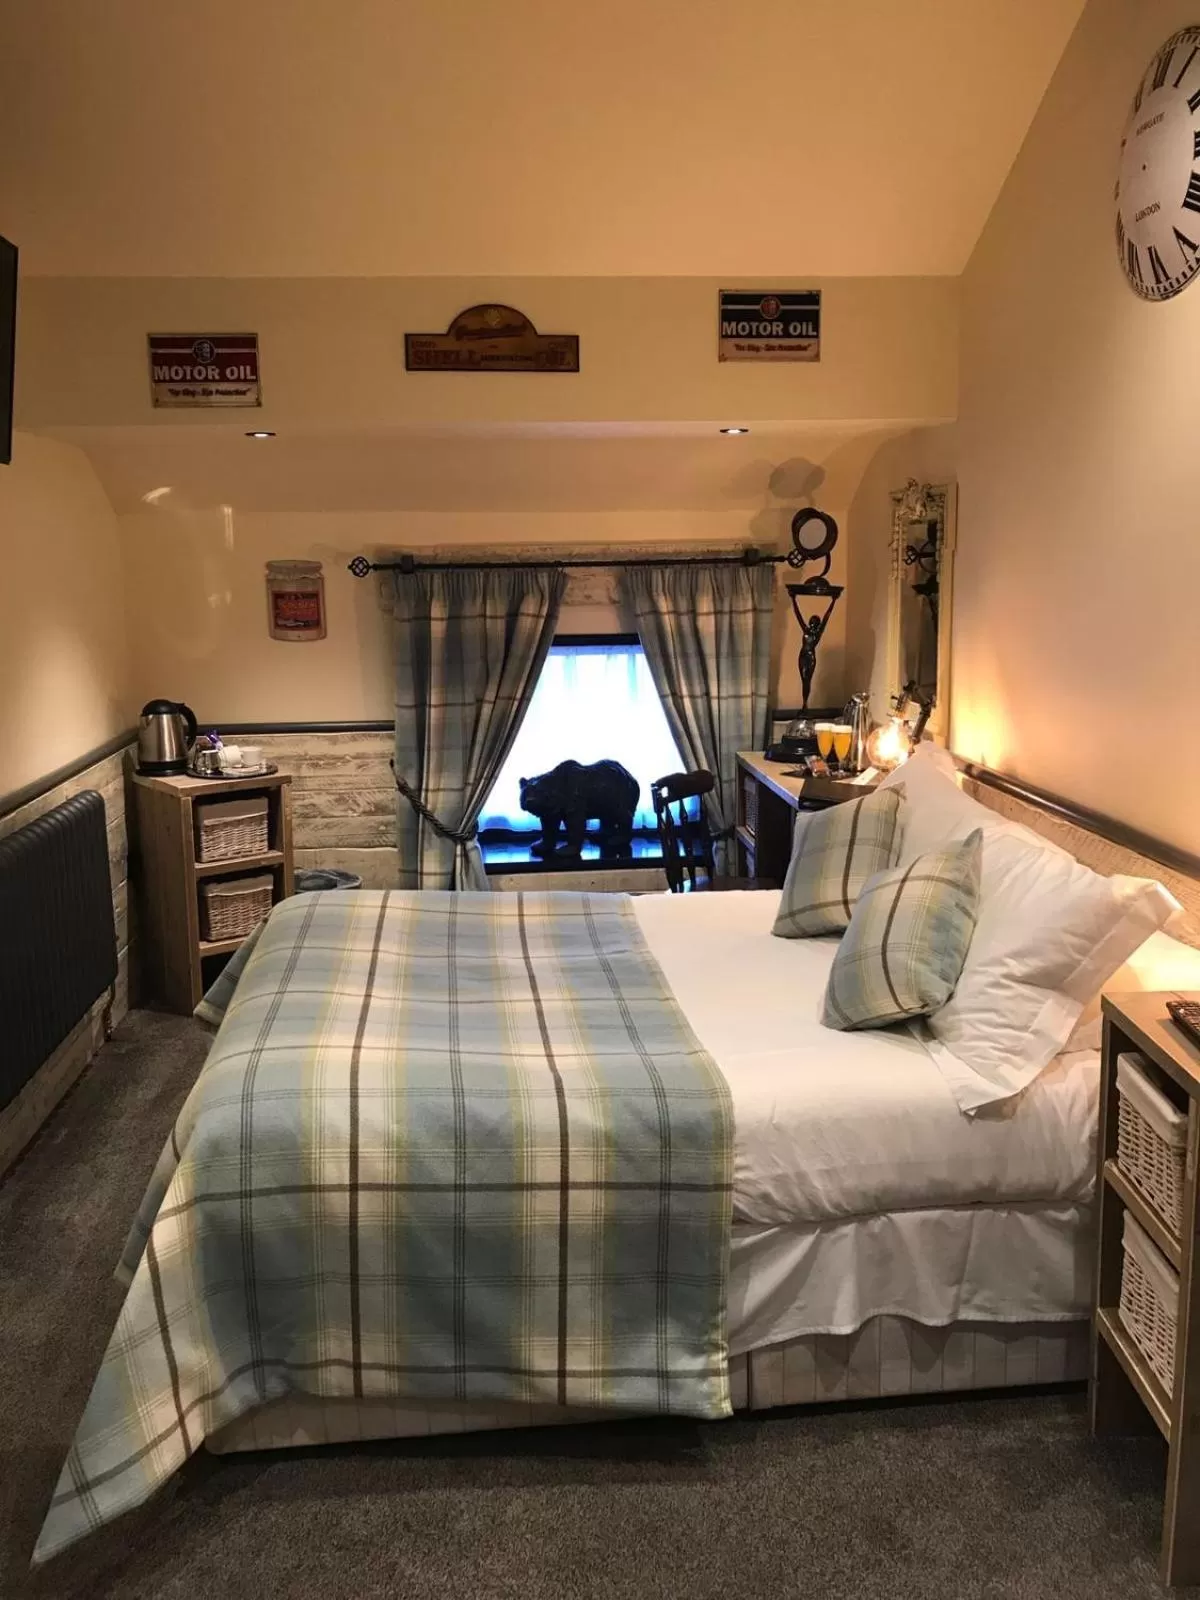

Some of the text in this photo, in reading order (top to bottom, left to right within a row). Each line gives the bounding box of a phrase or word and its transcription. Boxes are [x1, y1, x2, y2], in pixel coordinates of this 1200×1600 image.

[1135, 201, 1160, 222] LONDON
[722, 321, 817, 336] MOTOR OIL
[154, 365, 256, 380] MOTOR OIL
